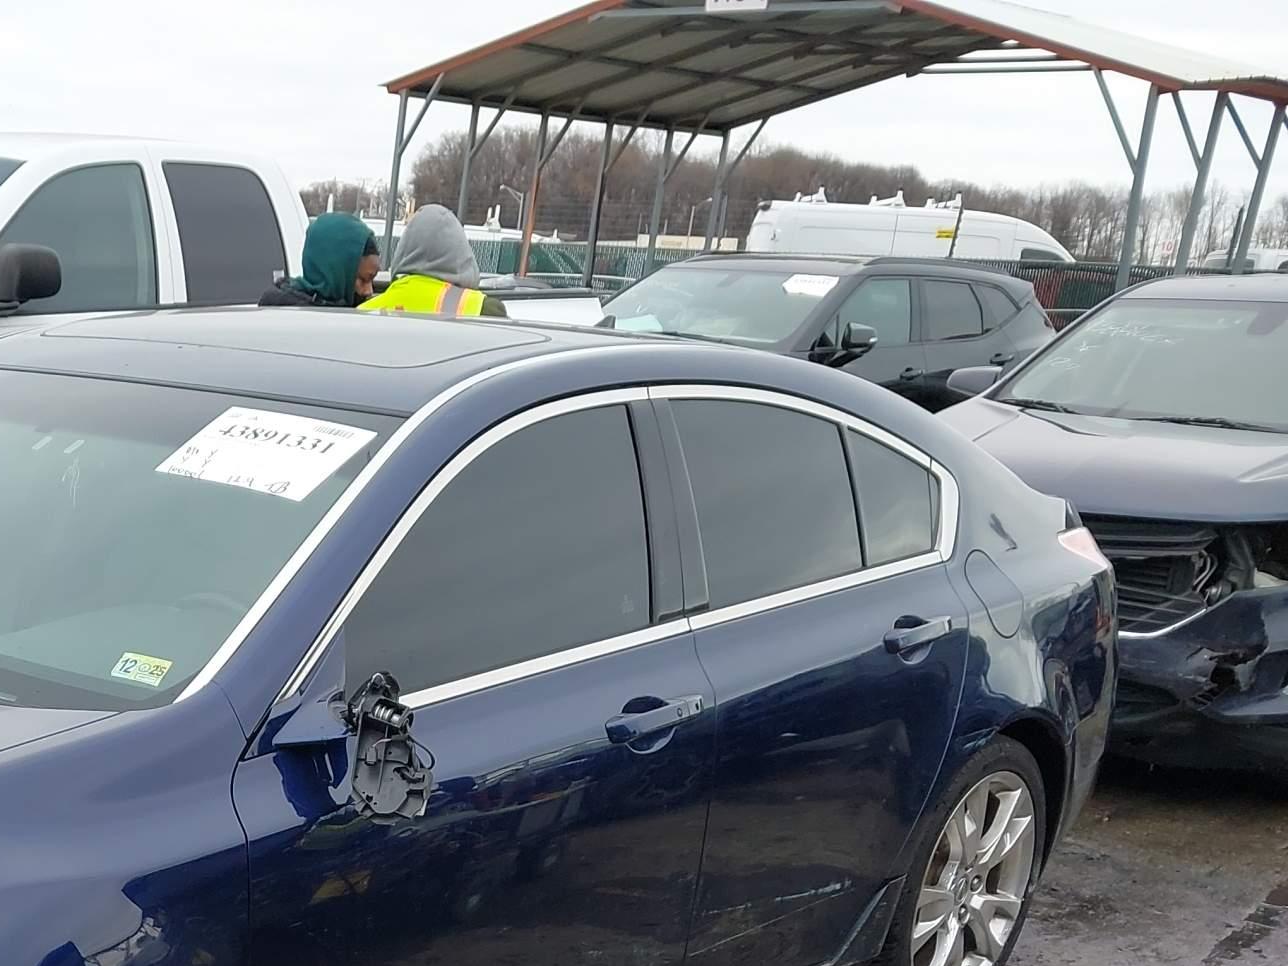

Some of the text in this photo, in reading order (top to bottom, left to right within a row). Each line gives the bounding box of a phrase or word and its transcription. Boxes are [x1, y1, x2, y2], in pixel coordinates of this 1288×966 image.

[219, 424, 335, 454] 43891331
[119, 658, 167, 677] 12 25
